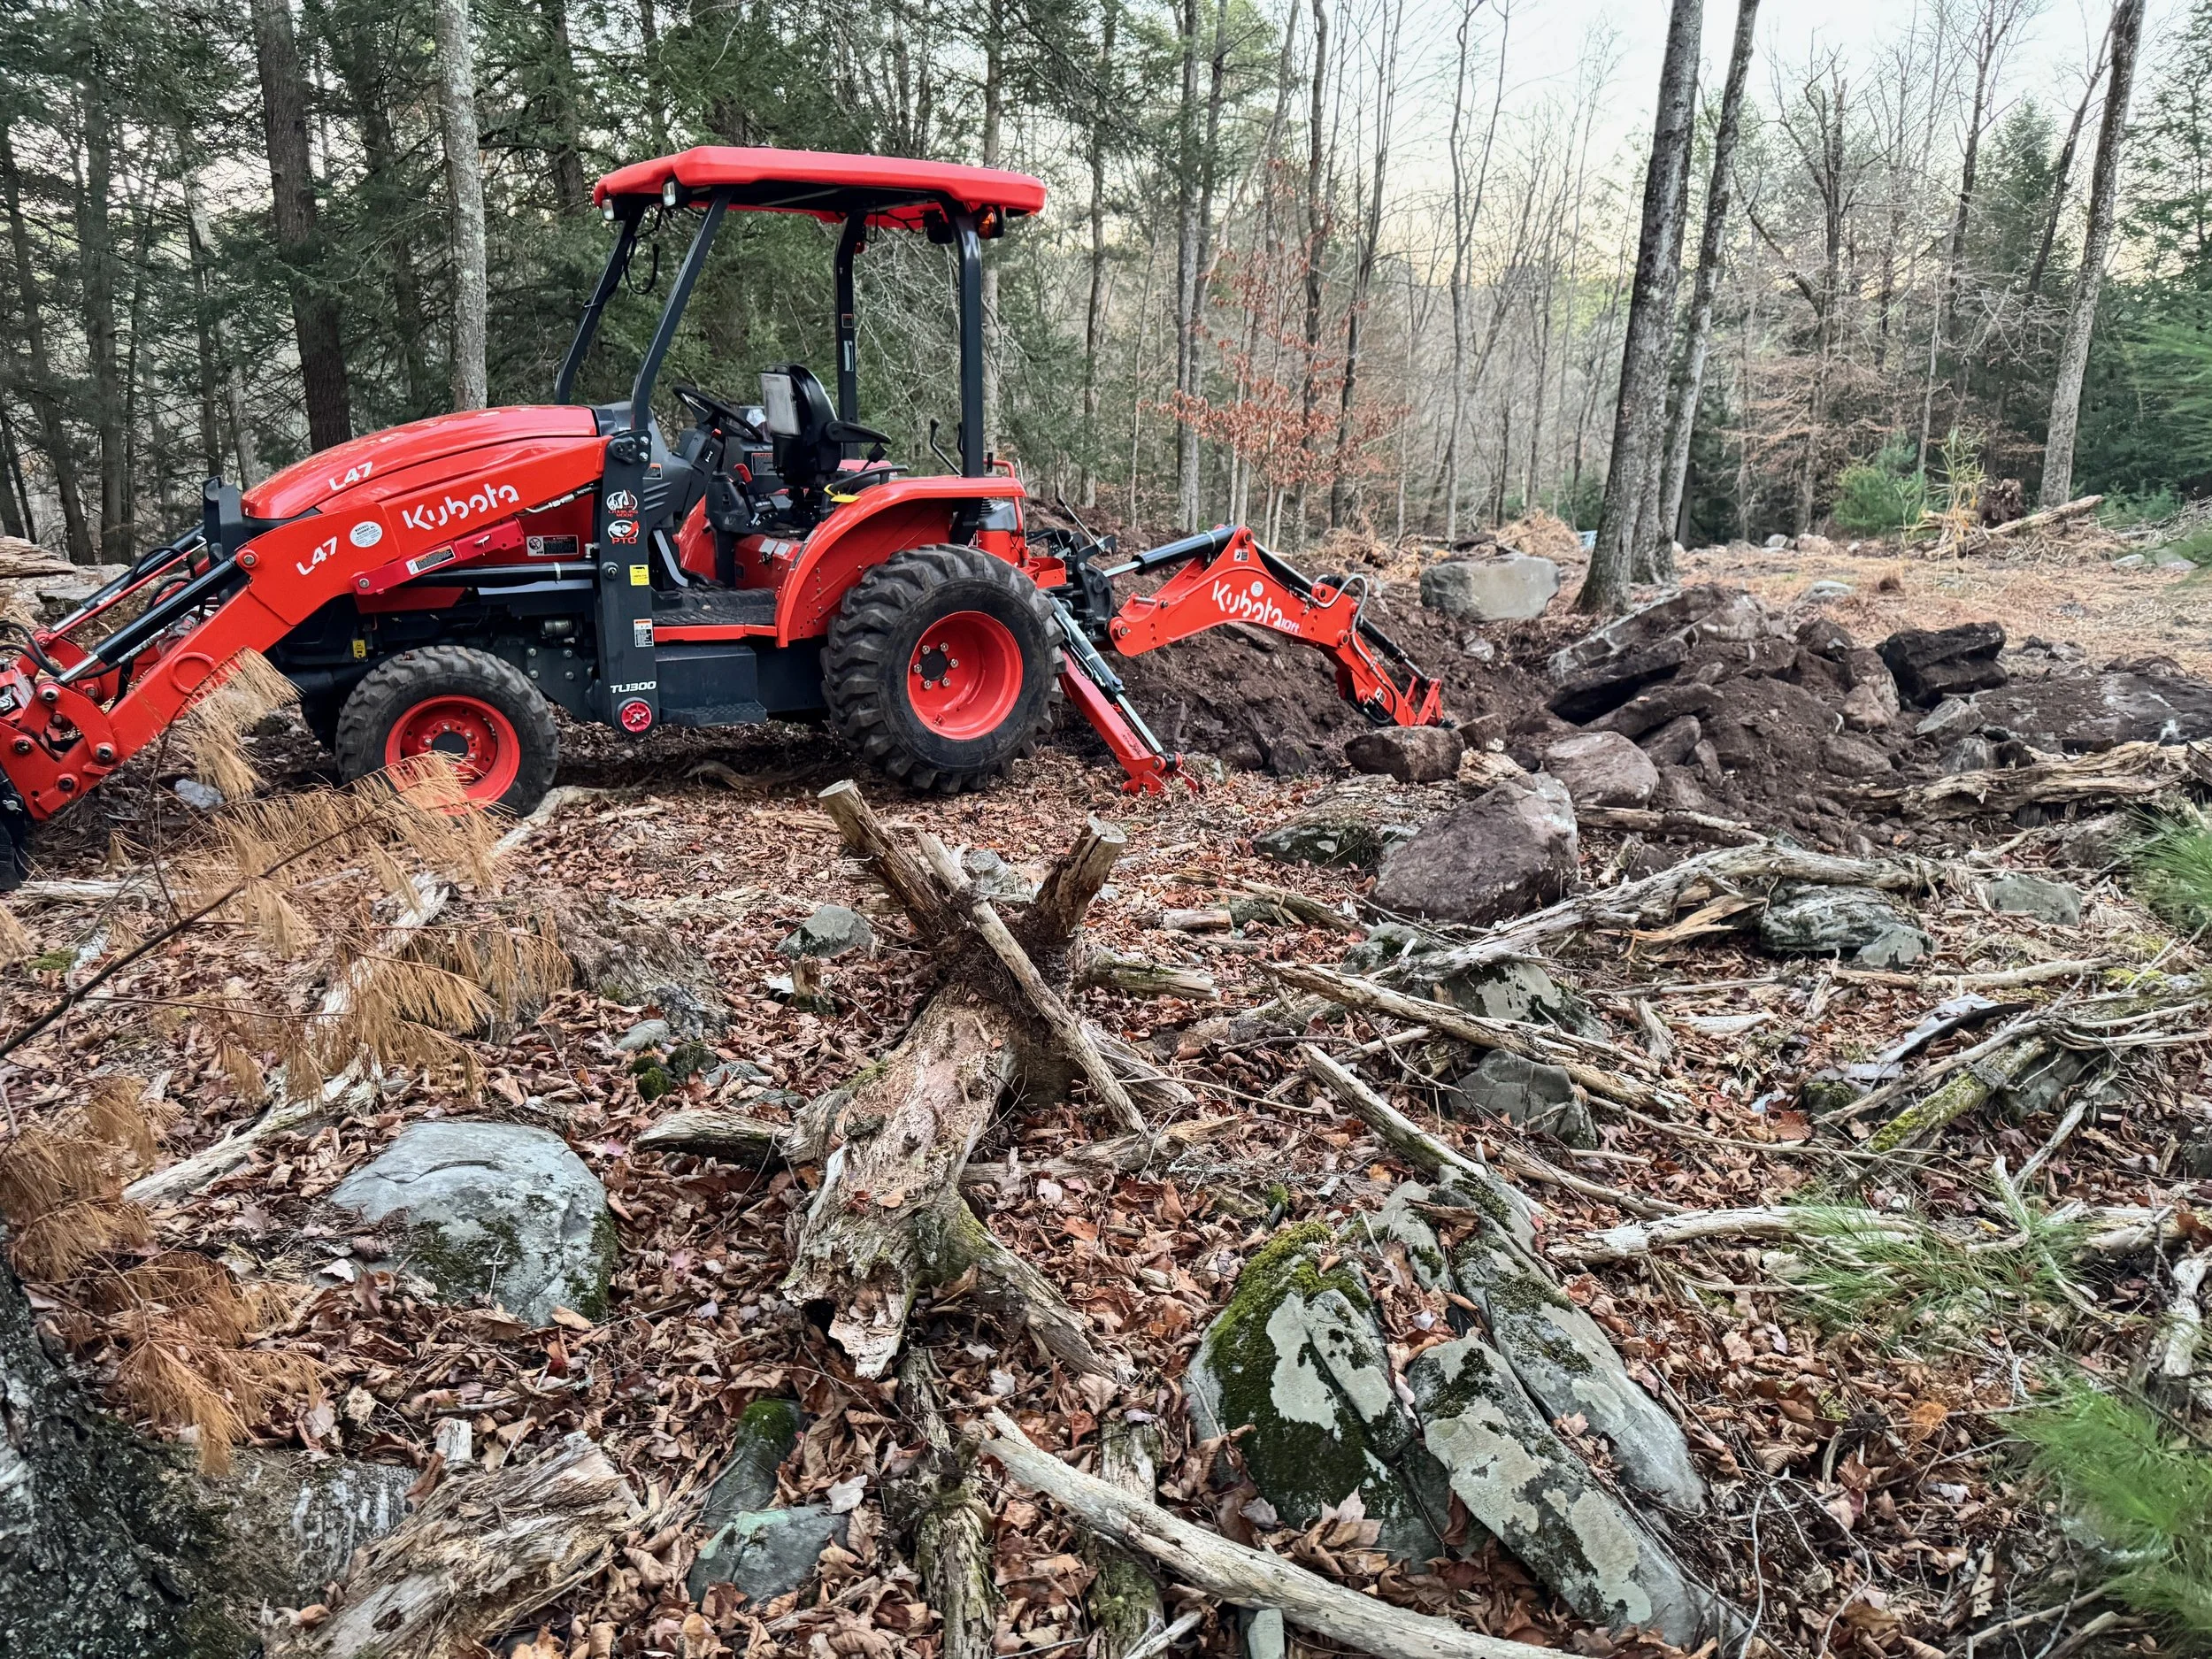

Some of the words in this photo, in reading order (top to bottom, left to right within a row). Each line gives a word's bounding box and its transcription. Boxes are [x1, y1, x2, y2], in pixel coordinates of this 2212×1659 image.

[328, 461, 373, 491] L47
[402, 483, 519, 530] Kubota
[296, 535, 338, 576] L47
[1211, 580, 1283, 628] Kubota
[1280, 618, 1300, 634] 10ft
[610, 680, 657, 694] TL1300
